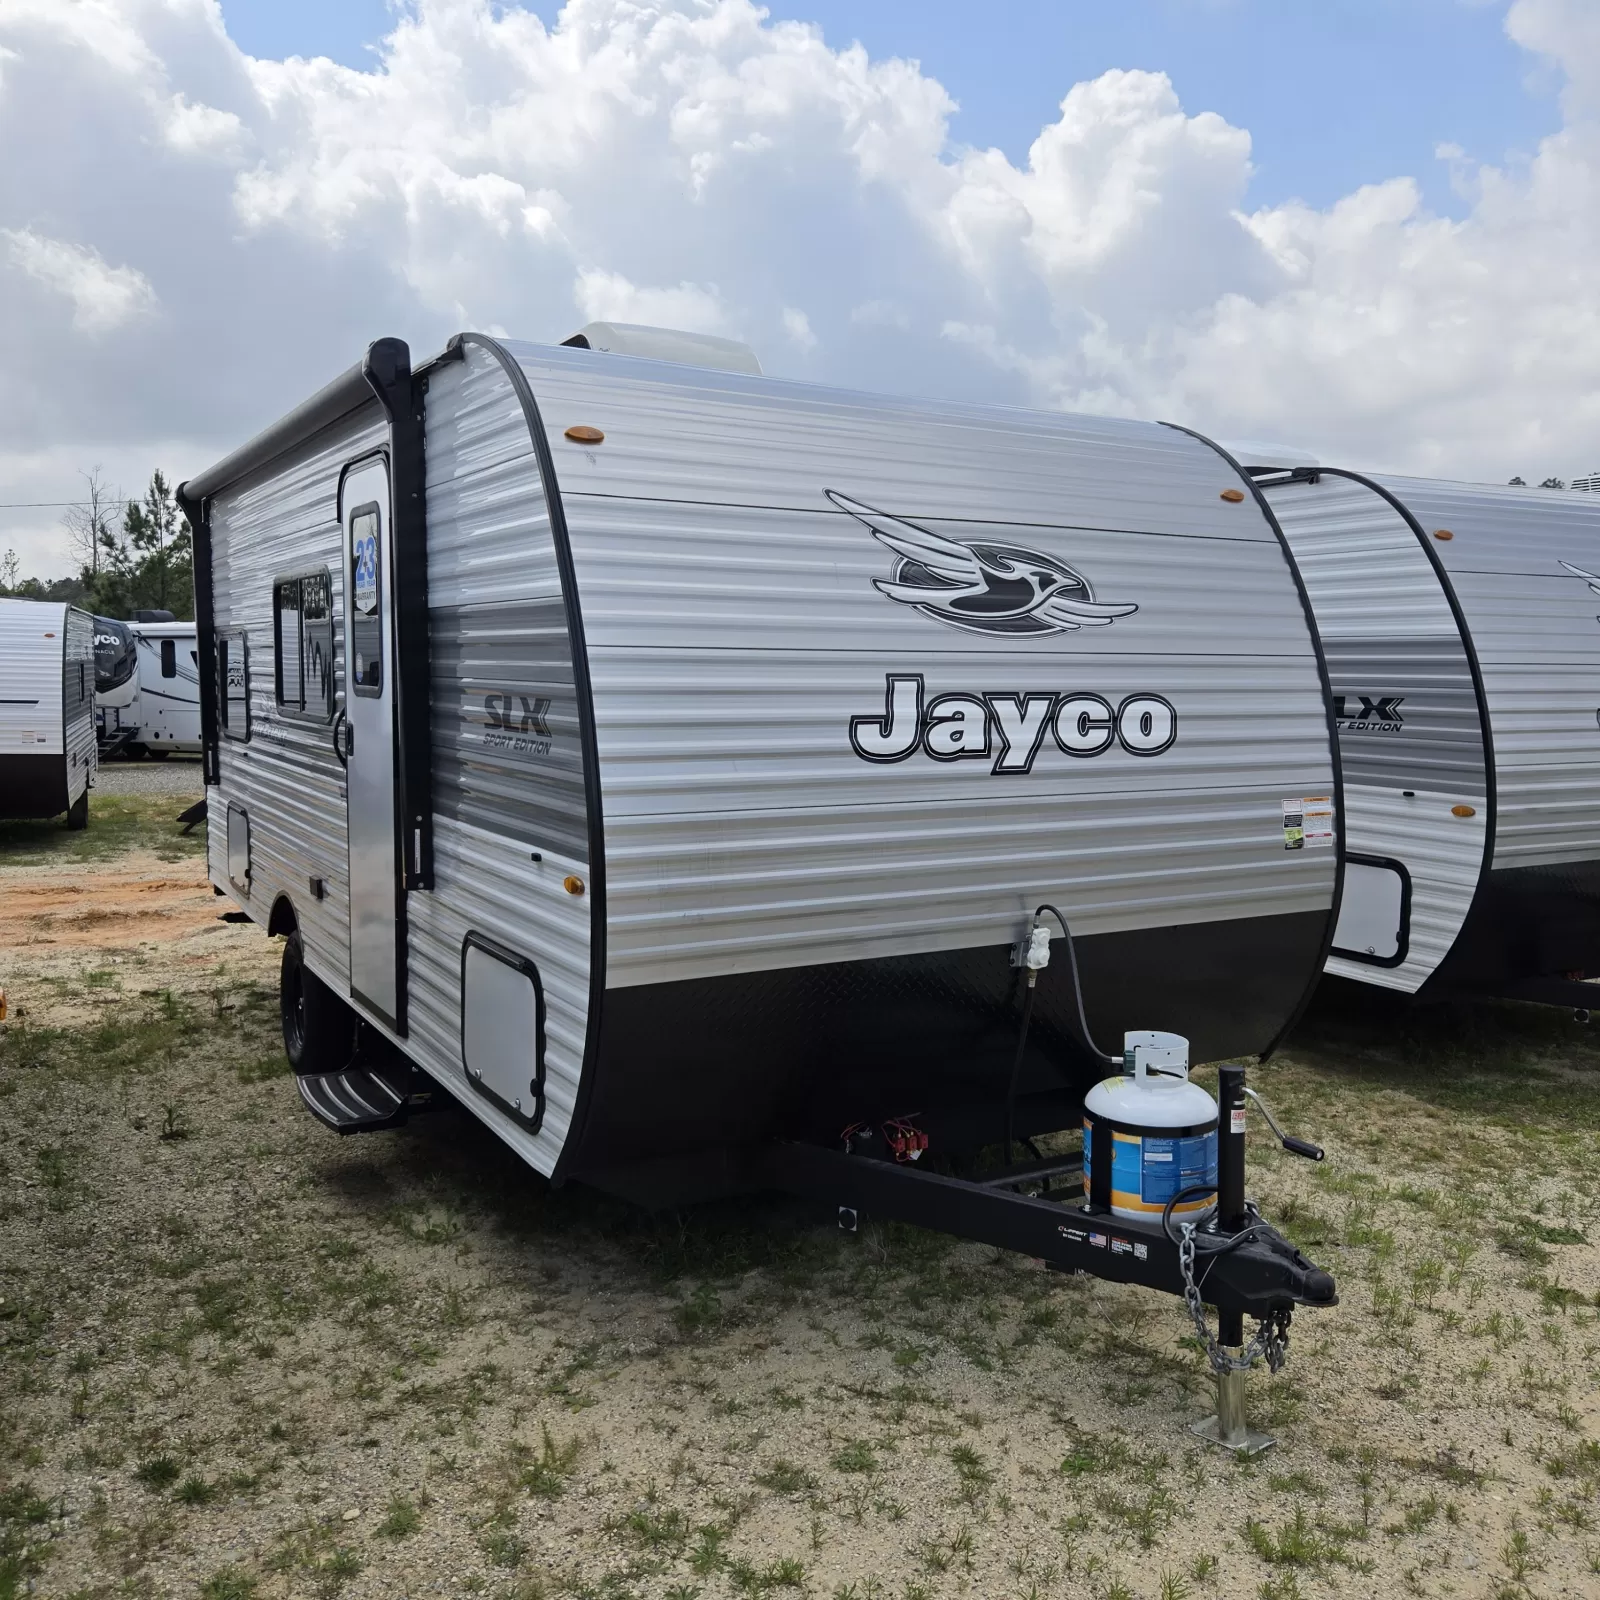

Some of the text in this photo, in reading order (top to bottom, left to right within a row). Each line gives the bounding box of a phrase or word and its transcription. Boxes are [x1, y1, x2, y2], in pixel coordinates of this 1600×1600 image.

[356, 591, 376, 600] WARRANTY
[94, 634, 120, 646] yco
[484, 695, 552, 738] SLX
[1333, 695, 1405, 722] LX
[849, 672, 1177, 776] Jayco
[1347, 721, 1402, 732] EDITION
[483, 733, 551, 755] SPORT EDITION
